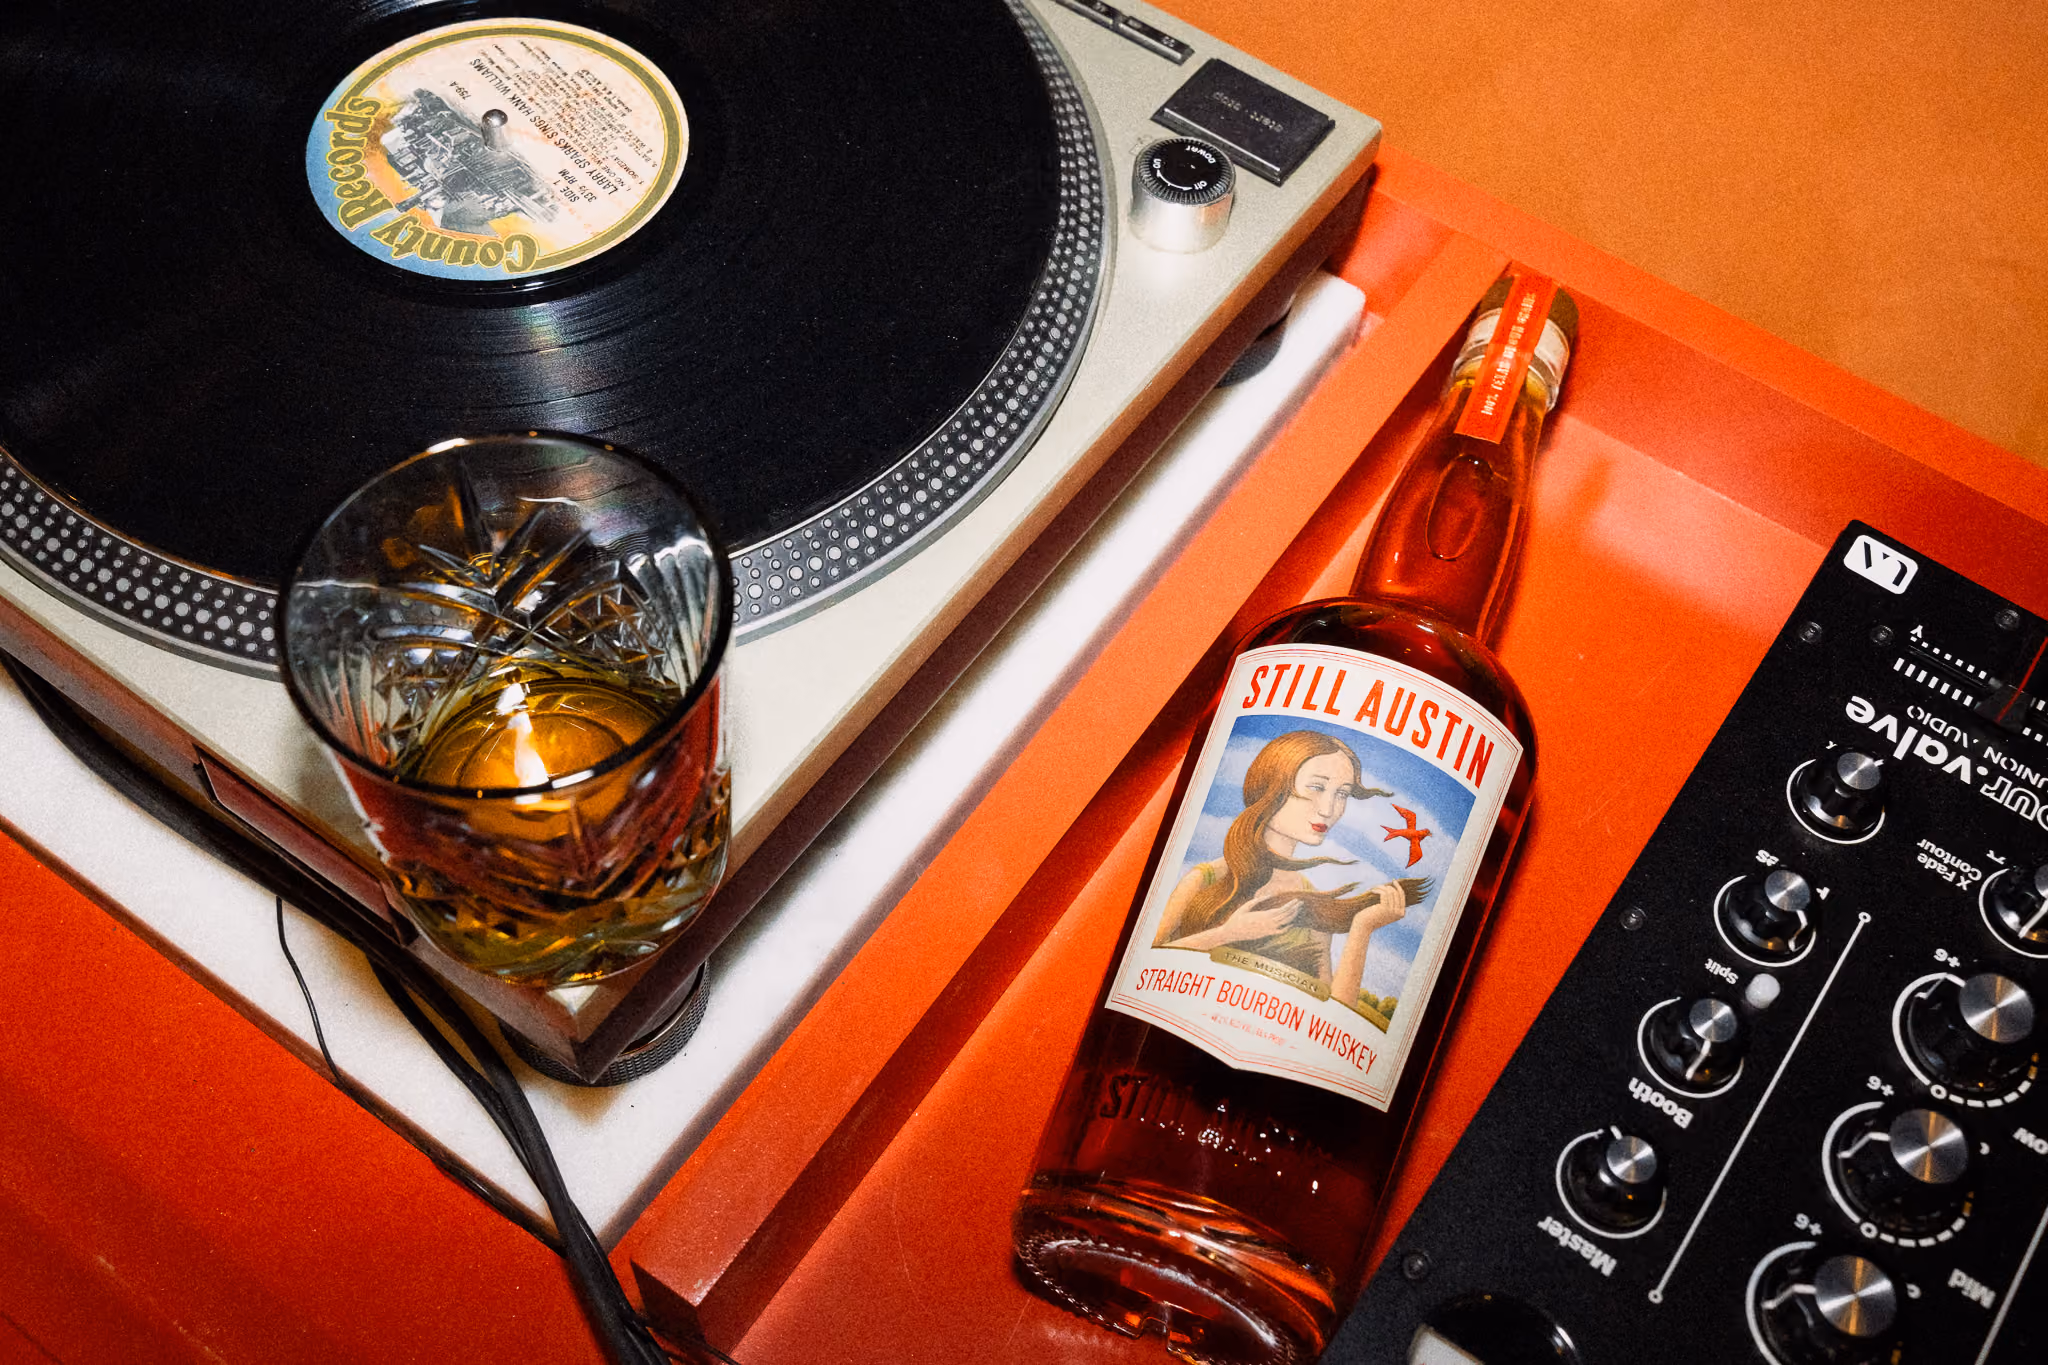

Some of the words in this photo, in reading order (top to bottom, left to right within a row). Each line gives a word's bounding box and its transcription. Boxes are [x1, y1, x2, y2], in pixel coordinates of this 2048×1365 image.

[449, 80, 473, 101] 759-A
[468, 57, 512, 95] WILLIAMS
[506, 93, 535, 116] HANK
[528, 114, 559, 139] SINGS
[324, 97, 396, 232] Records
[552, 137, 591, 169] SPARKS
[1186, 145, 1216, 165] power
[558, 168, 579, 186] RPM
[584, 166, 619, 195] LARRY
[560, 185, 581, 204] SIDE
[370, 212, 541, 274] County
[1243, 664, 1347, 716] STILL
[1354, 679, 1495, 789] AUSTIN
[1917, 838, 1982, 881] Contour
[1917, 852, 1957, 882] Fade
[1957, 876, 1973, 891] X
[1224, 952, 1249, 966] THE
[1254, 961, 1319, 993] MUSICIAN
[1705, 958, 1739, 985] Split
[1136, 968, 1216, 999] STRAIGHT
[1216, 980, 1305, 1032] BOURBON
[1308, 1014, 1378, 1075] WHISKEY
[1628, 1077, 1694, 1129] Booth
[1537, 1216, 1618, 1277] Master
[1948, 1268, 1996, 1309] Mid
